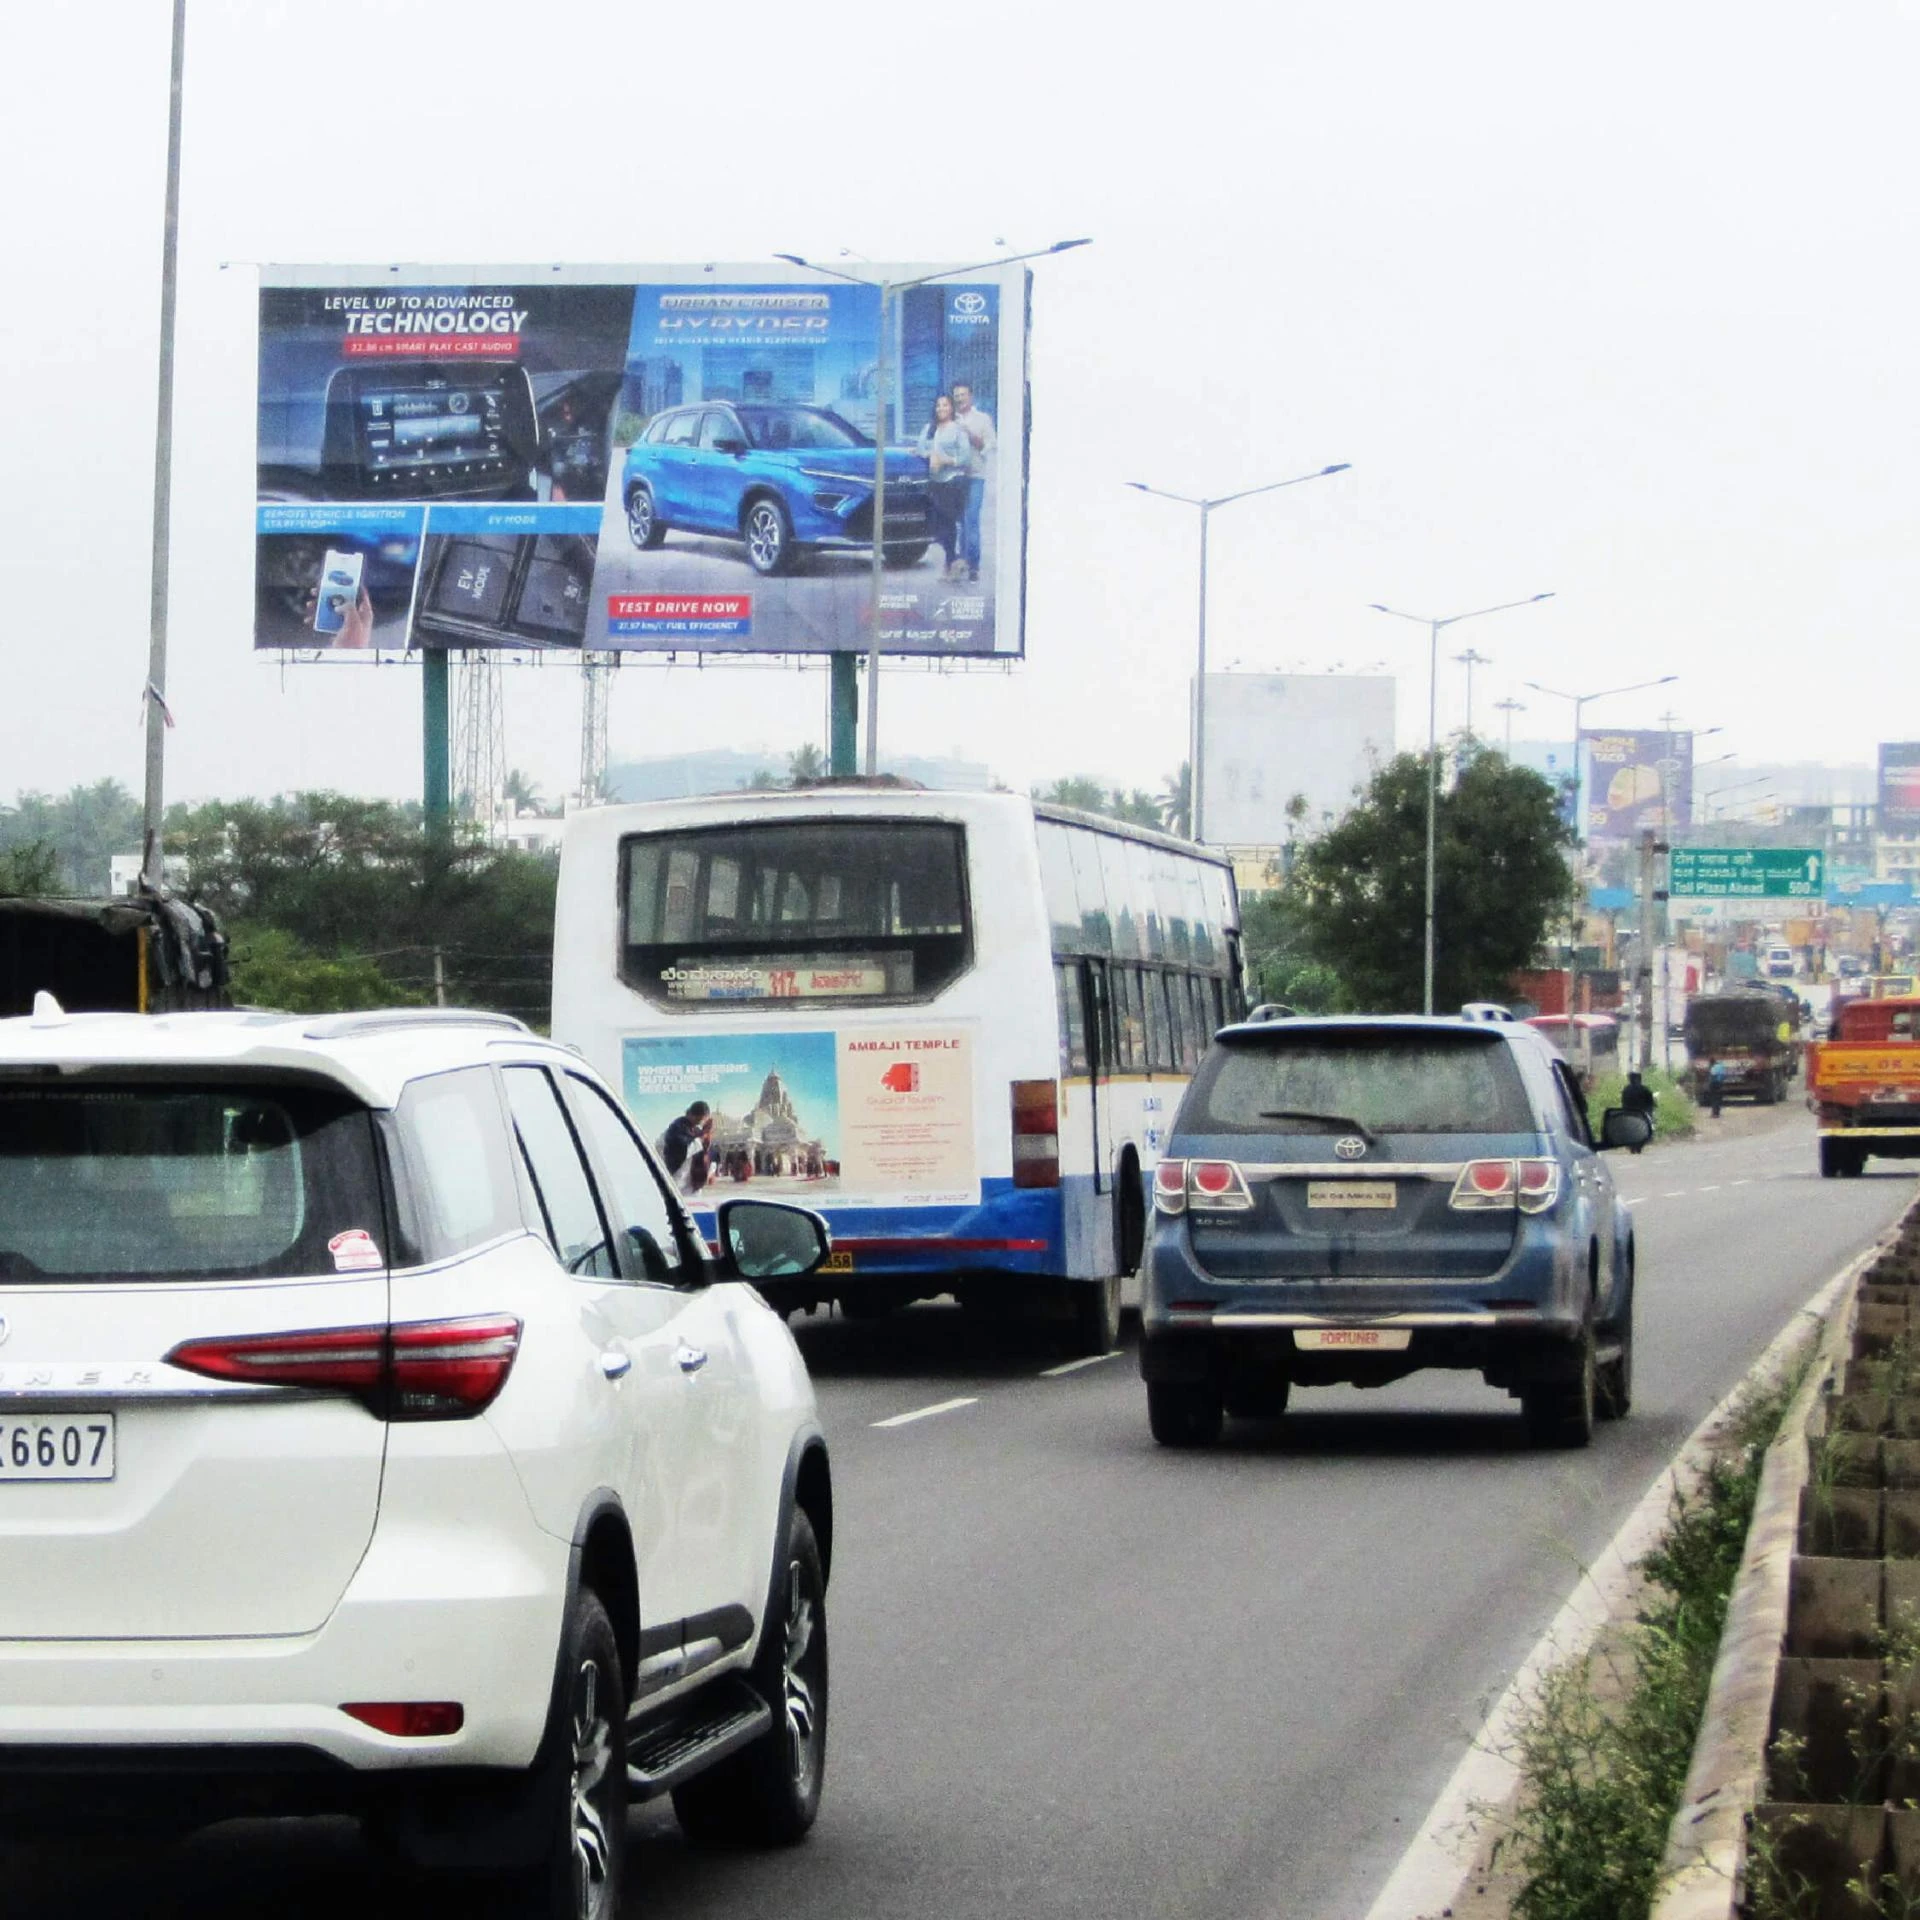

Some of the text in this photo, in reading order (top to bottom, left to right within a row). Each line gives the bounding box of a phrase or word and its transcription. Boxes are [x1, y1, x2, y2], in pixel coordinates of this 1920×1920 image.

[325, 296, 514, 309] LEVEL UP TO ADVANCED
[665, 299, 824, 309] URBAN CRUISER
[346, 311, 528, 333] TECHNOLOGY
[949, 315, 990, 325] TOYOTA
[396, 343, 426, 352] SMART
[430, 342, 452, 352] PLAY
[481, 342, 513, 351] AUDIO
[505, 516, 537, 524] MODE
[457, 569, 474, 590] EV
[472, 567, 491, 599] MODE
[619, 602, 739, 613] TEST DRIVE NOW
[666, 621, 686, 630] FUEL
[689, 621, 739, 630] EFFICIENCY
[1674, 882, 1695, 894] Toll
[1697, 882, 1726, 894] Plaza
[1728, 882, 1764, 894] Ahead
[848, 1039, 960, 1051] AMBAJI TEMPLE
[639, 1065, 683, 1074] WHERE
[639, 1074, 721, 1084] OUTNUMBER
[1320, 1332, 1378, 1345] FORTUNER
[0, 1371, 152, 1386] NER
[0, 1425, 108, 1468] 6607
